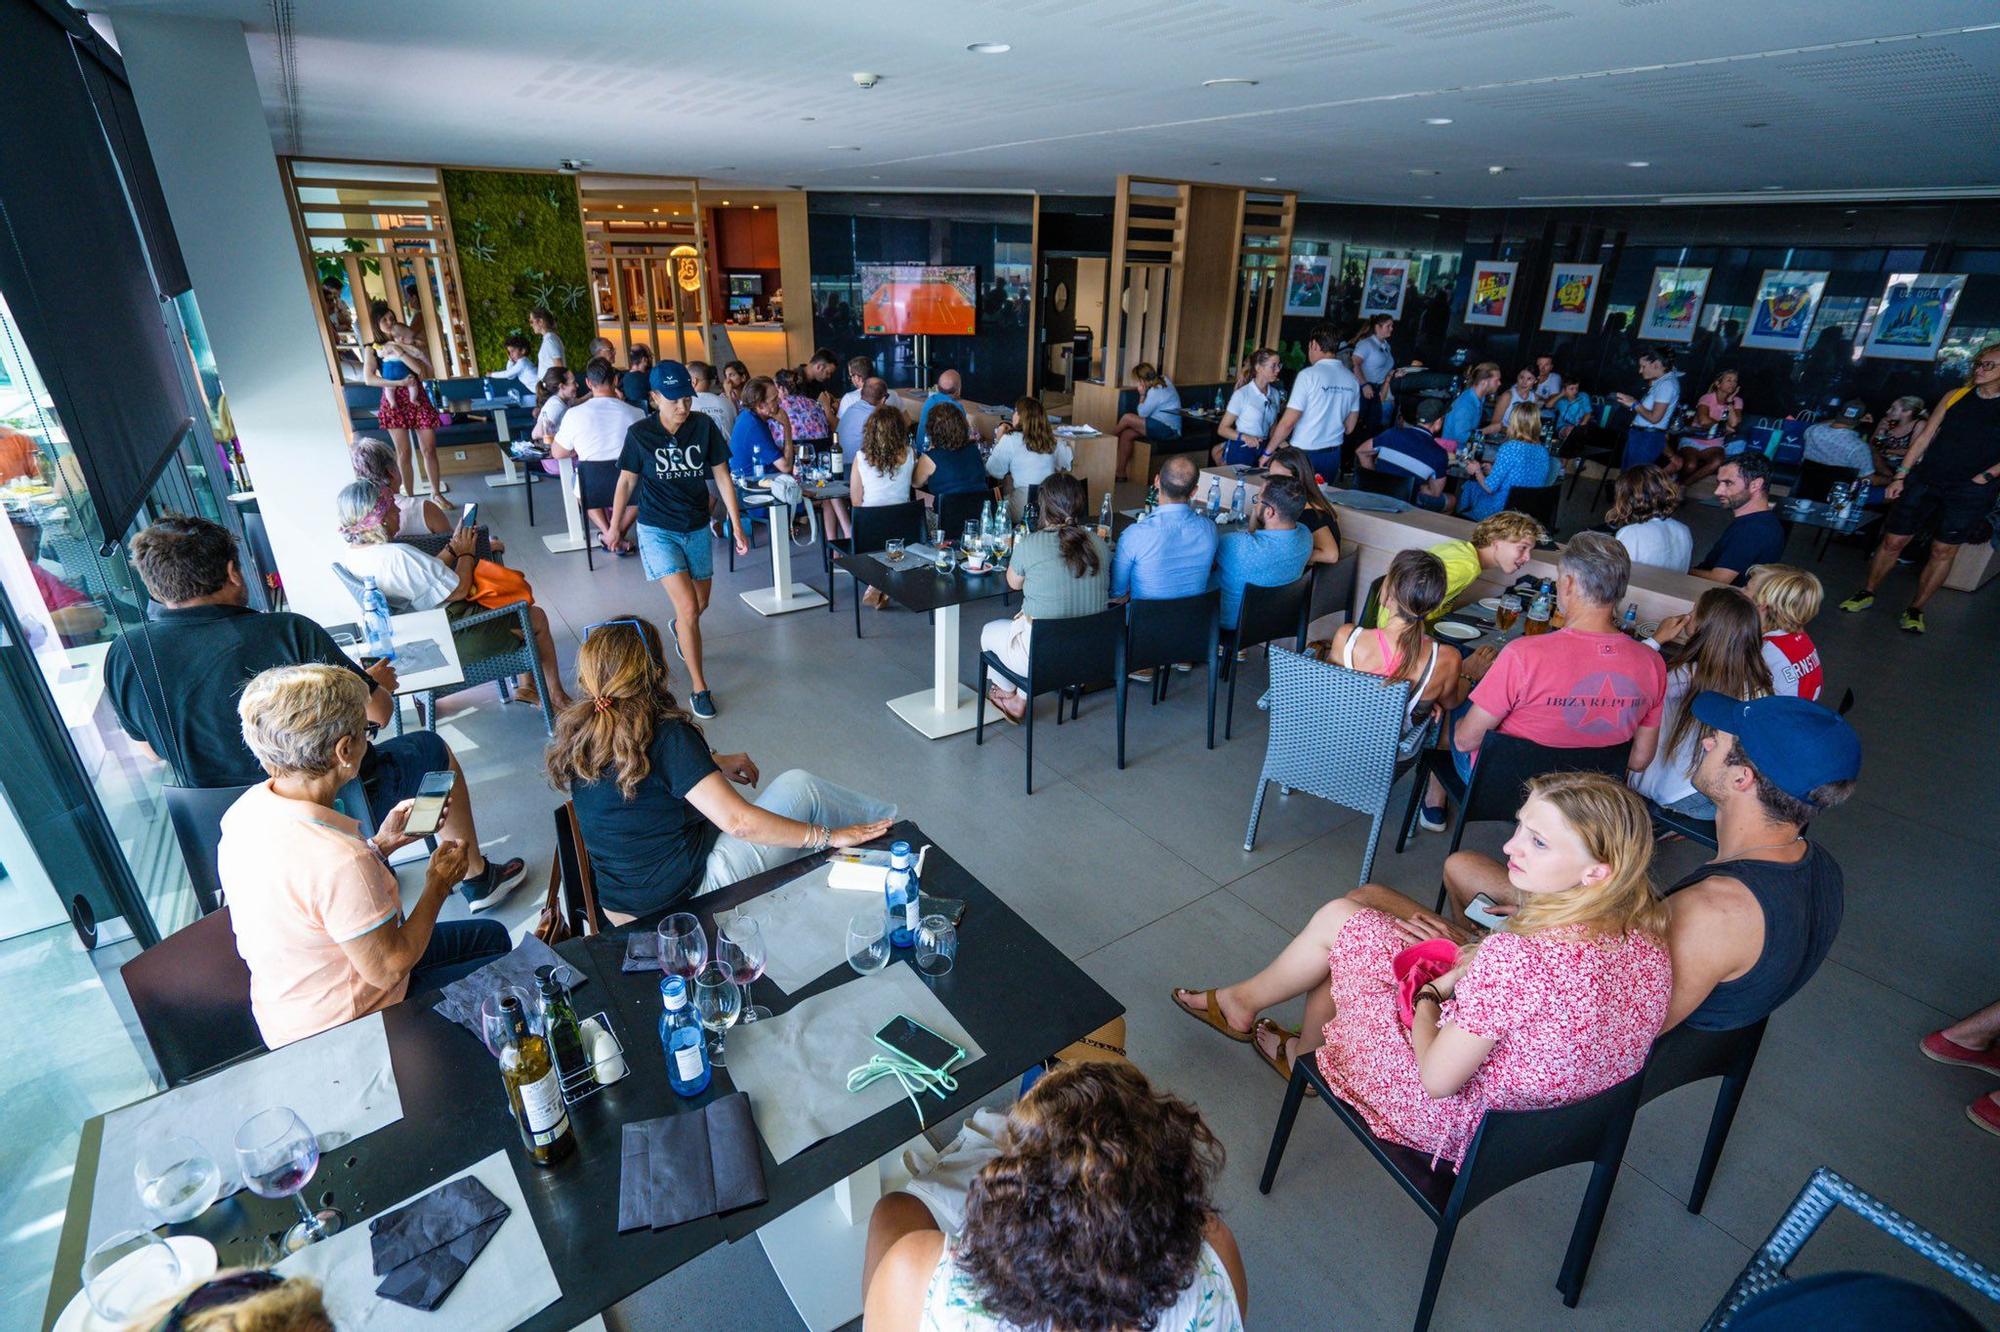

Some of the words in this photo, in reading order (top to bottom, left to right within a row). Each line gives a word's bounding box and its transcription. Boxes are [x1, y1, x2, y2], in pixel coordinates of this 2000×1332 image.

[655, 444, 704, 473] SRC
[656, 469, 704, 480] TENNIS
[1546, 697, 1587, 708] IBIZA
